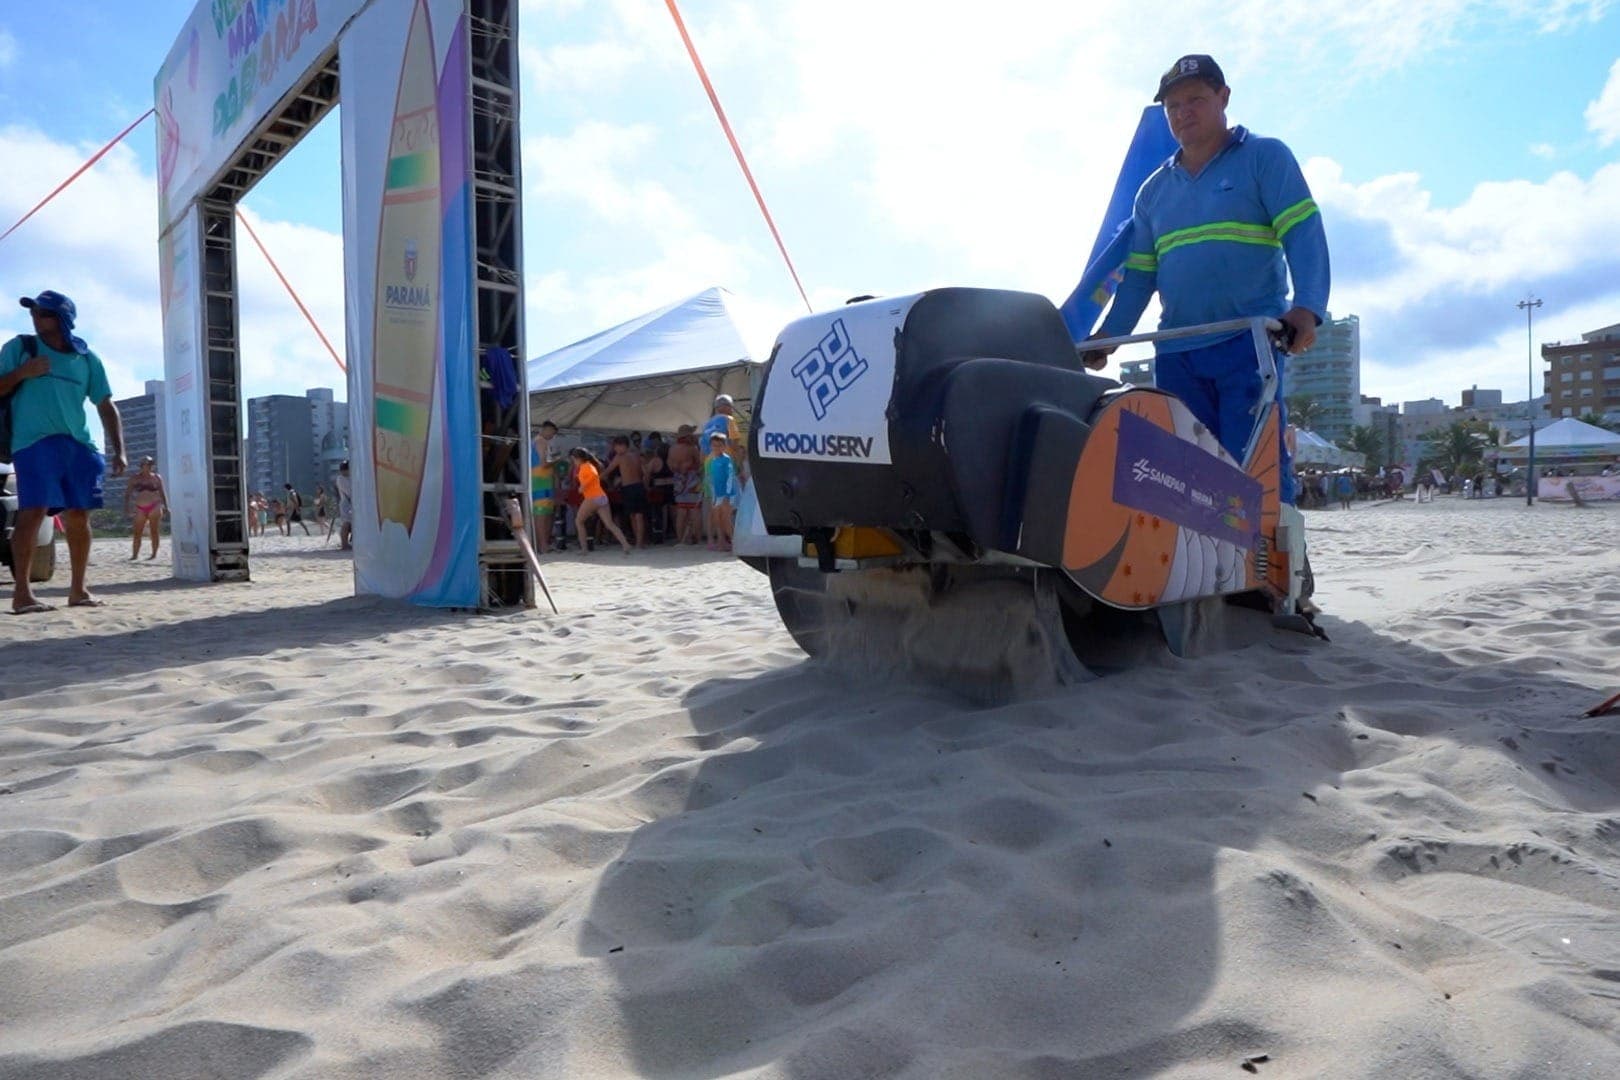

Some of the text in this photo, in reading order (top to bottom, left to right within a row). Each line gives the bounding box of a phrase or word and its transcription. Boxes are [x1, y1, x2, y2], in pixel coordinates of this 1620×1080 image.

[386, 283, 430, 306] PARANÁ
[764, 432, 873, 458] PRODUSERV
[1149, 468, 1186, 494] SANEPAR
